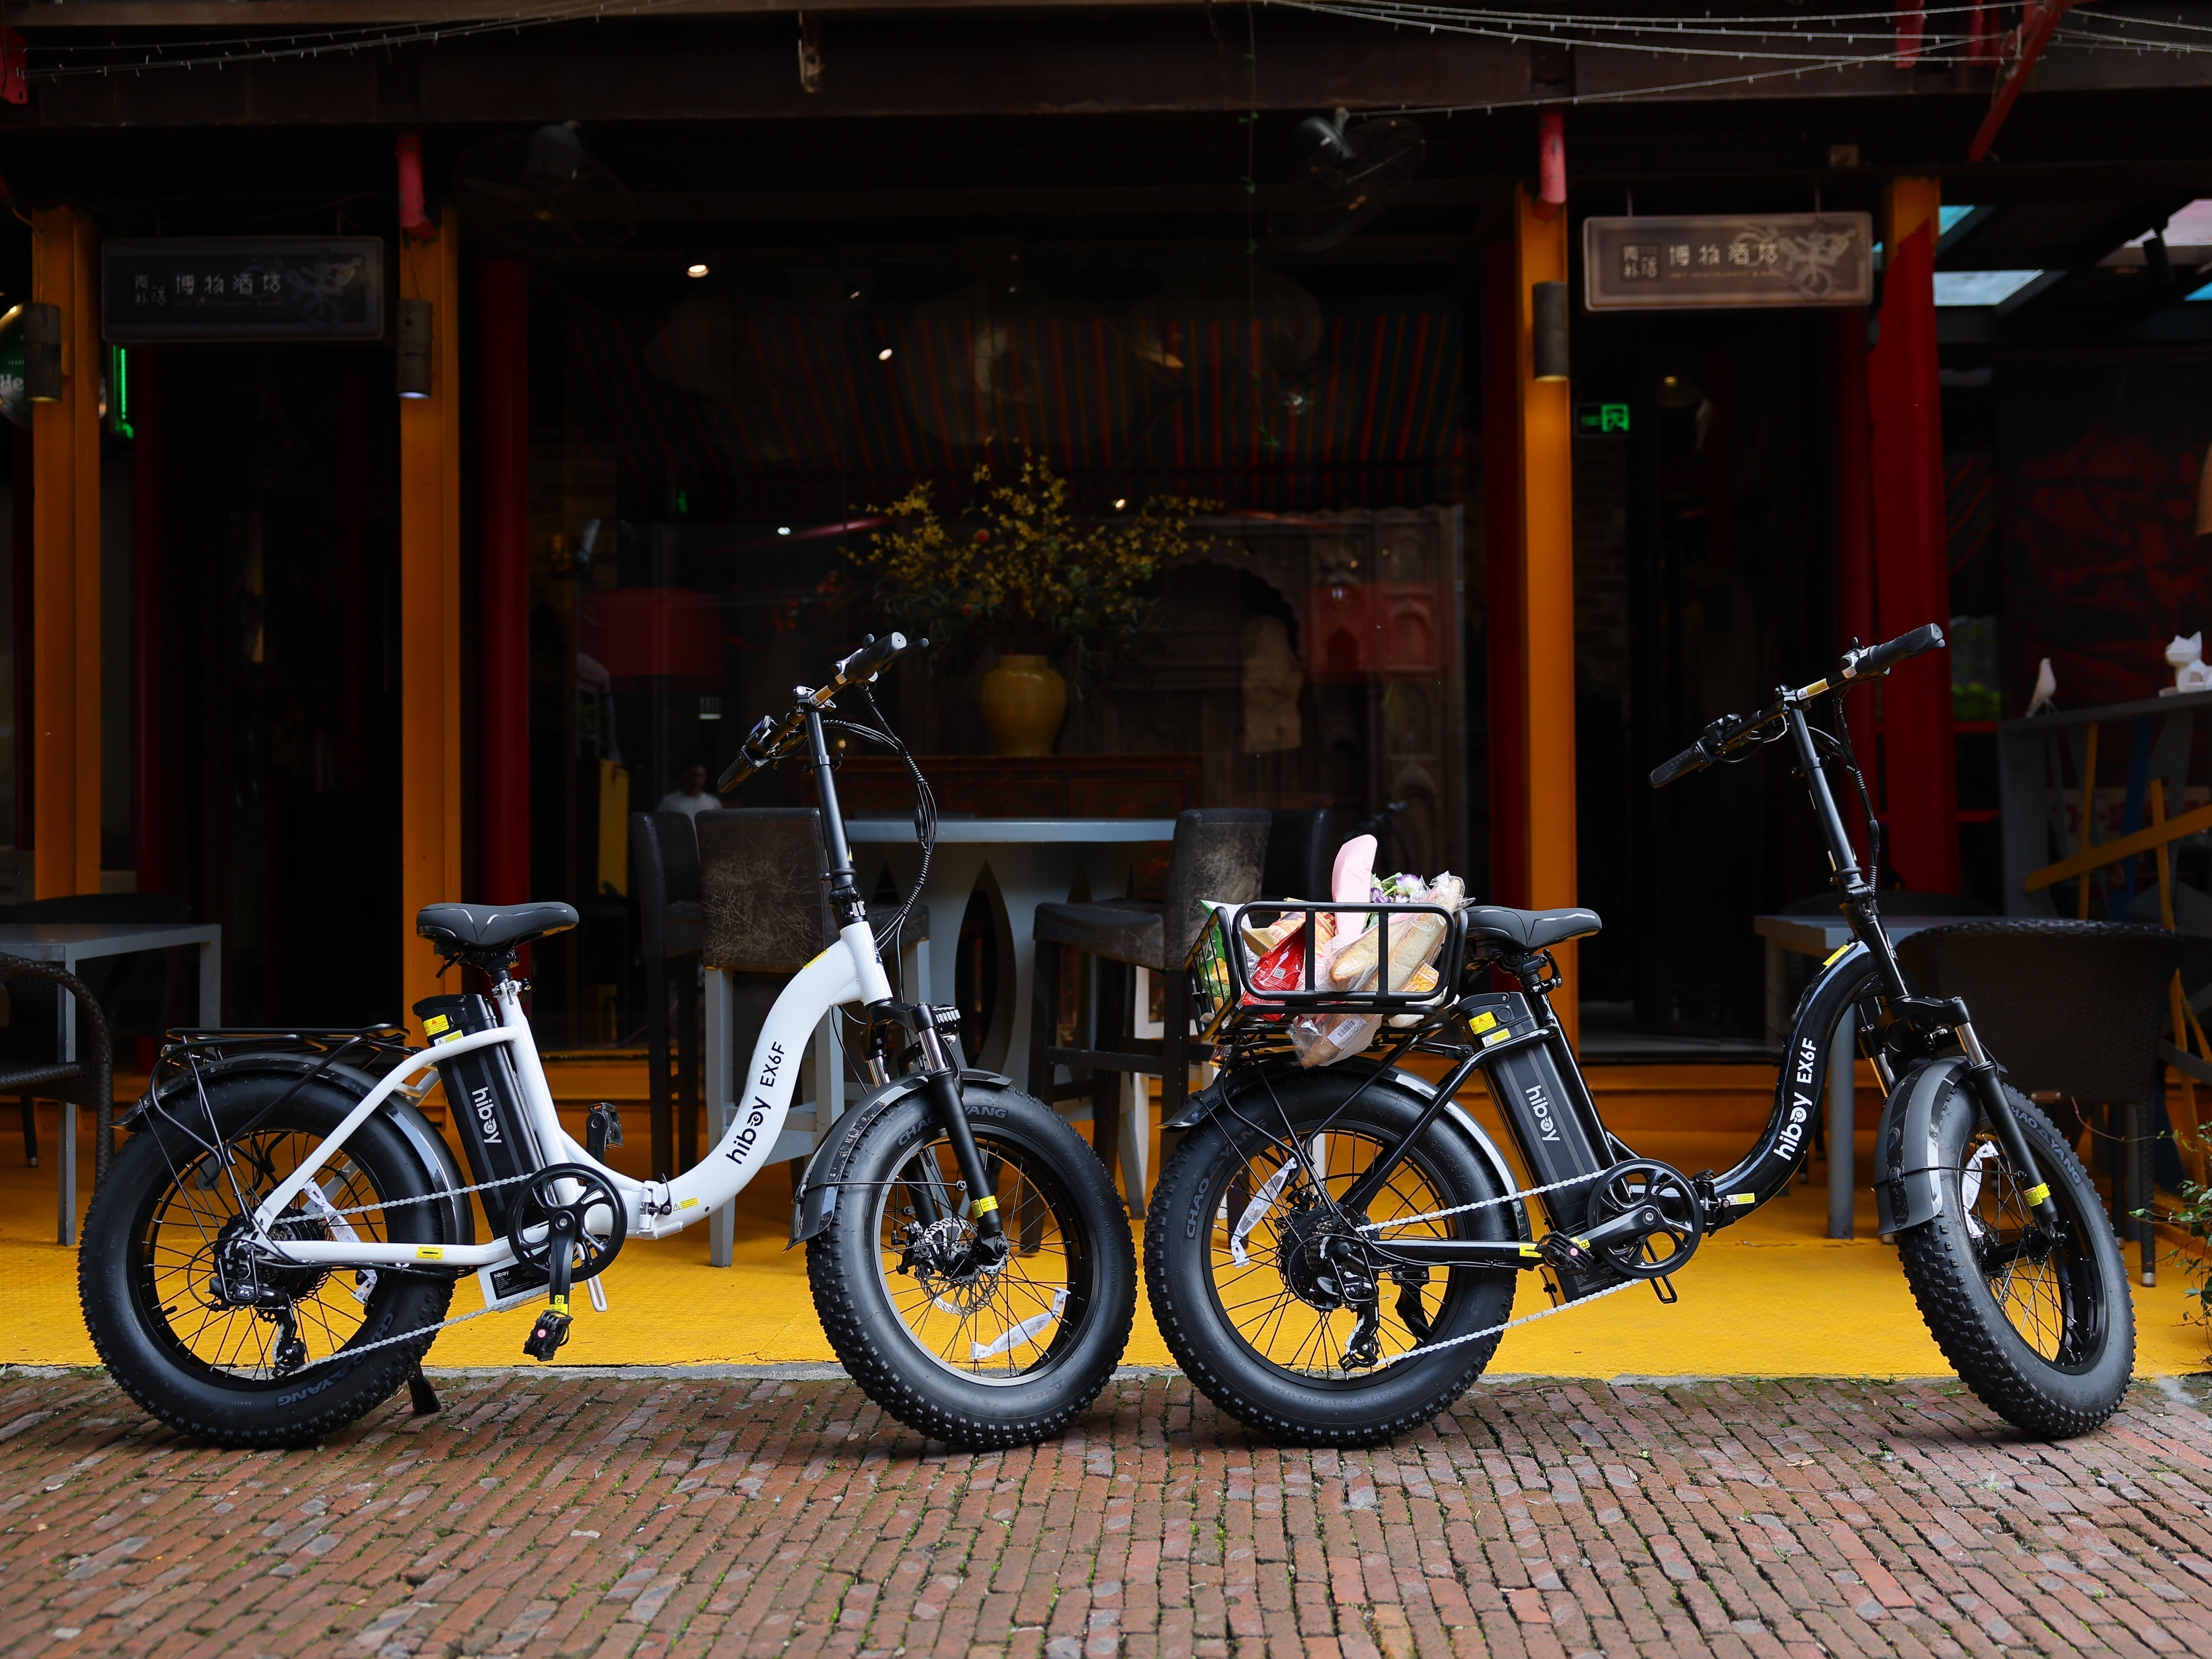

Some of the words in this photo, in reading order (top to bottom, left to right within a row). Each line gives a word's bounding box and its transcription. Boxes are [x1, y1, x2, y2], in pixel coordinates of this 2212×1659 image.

[472, 1087, 502, 1144] hiboy
[726, 1095, 772, 1165] hiboy
[760, 1041, 785, 1087] EX6F
[1526, 1085, 1560, 1141] hiboy
[1773, 1091, 1813, 1161] hiboy
[1796, 1037, 1817, 1084] EX6F
[898, 1113, 939, 1146] CHAO
[963, 1105, 1008, 1119] YANG
[2011, 1106, 2037, 1129] HAO
[2051, 1138, 2081, 1184] YANG
[1186, 1177, 1210, 1238] CHAO
[1219, 1118, 1268, 1158] YANG
[1228, 1352, 1249, 1372] NYLON
[1399, 1379, 1416, 1391] MAX.
[277, 1378, 334, 1406] YANG
[1272, 1385, 1285, 1395] BAR
[1370, 1389, 1397, 1402] INFLATE
